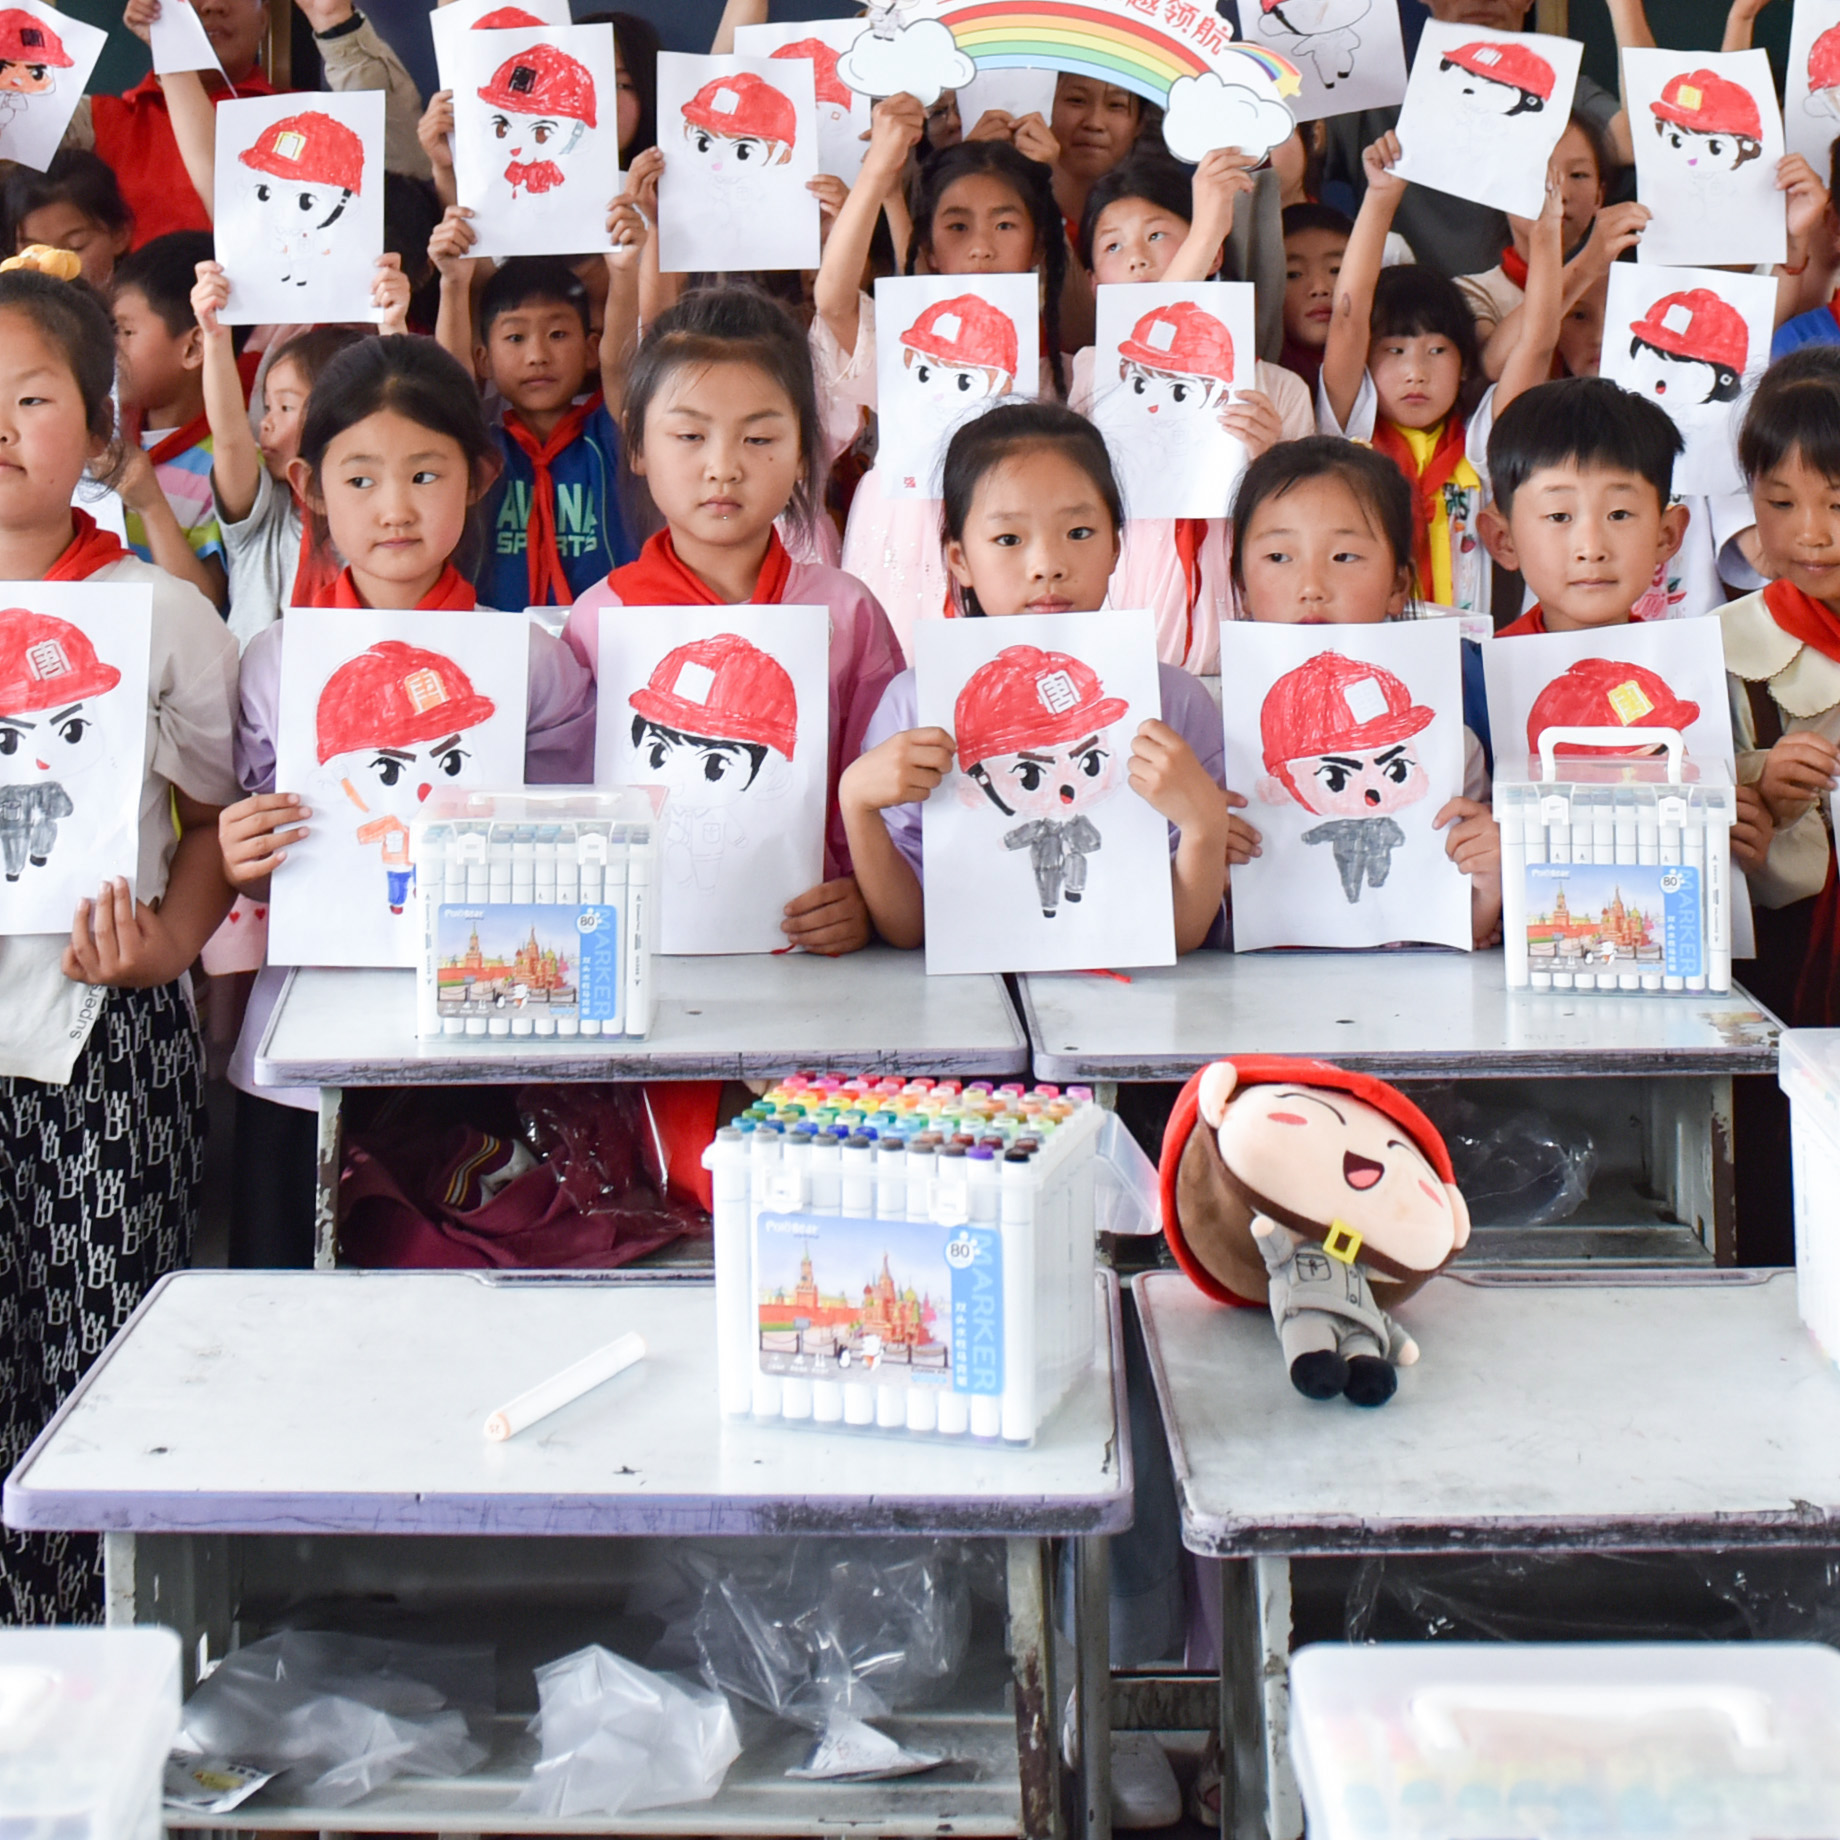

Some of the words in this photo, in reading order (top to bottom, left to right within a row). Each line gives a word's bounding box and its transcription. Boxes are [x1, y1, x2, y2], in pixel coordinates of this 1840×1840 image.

[496, 480, 598, 533] AVNA
[496, 531, 598, 558] SPRTS
[1663, 876, 1678, 887] 80
[580, 916, 595, 927] 80
[1678, 869, 1697, 973] MARKER
[594, 912, 611, 1017] MARKER
[950, 1243, 971, 1259] 80
[970, 1233, 998, 1393] MARKER
